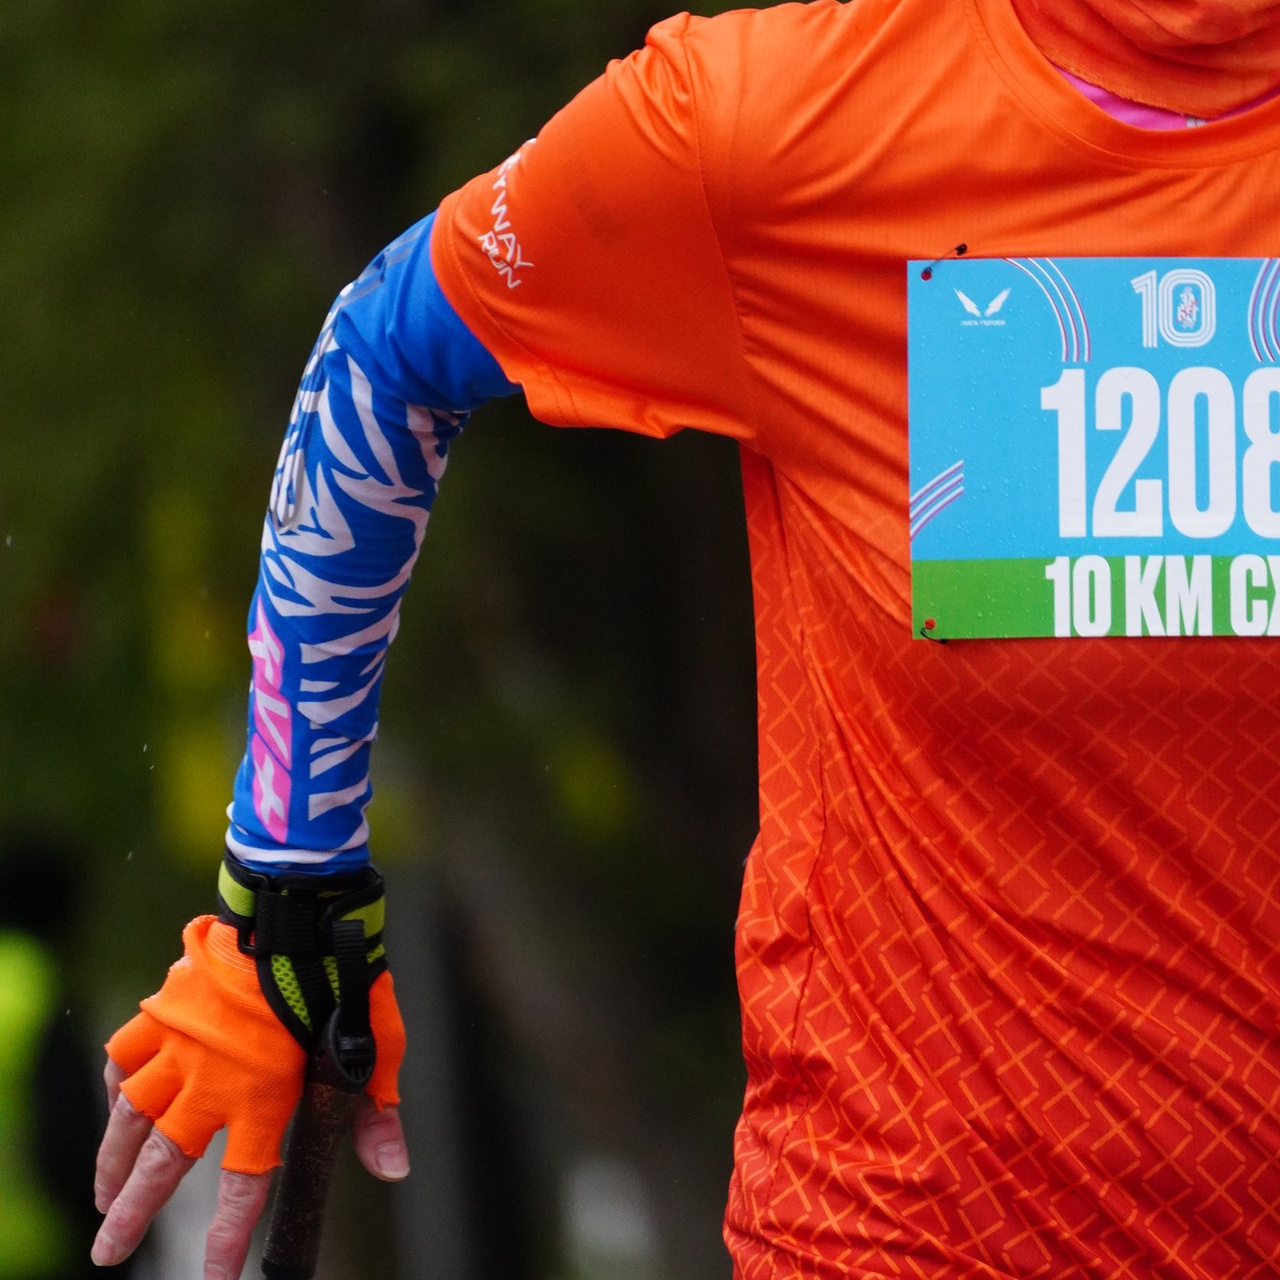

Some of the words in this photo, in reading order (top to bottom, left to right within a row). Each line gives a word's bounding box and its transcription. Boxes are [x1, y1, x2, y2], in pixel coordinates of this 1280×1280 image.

[478, 231, 522, 289] RUN
[1130, 269, 1216, 348] 10
[1045, 555, 1111, 637] 10
